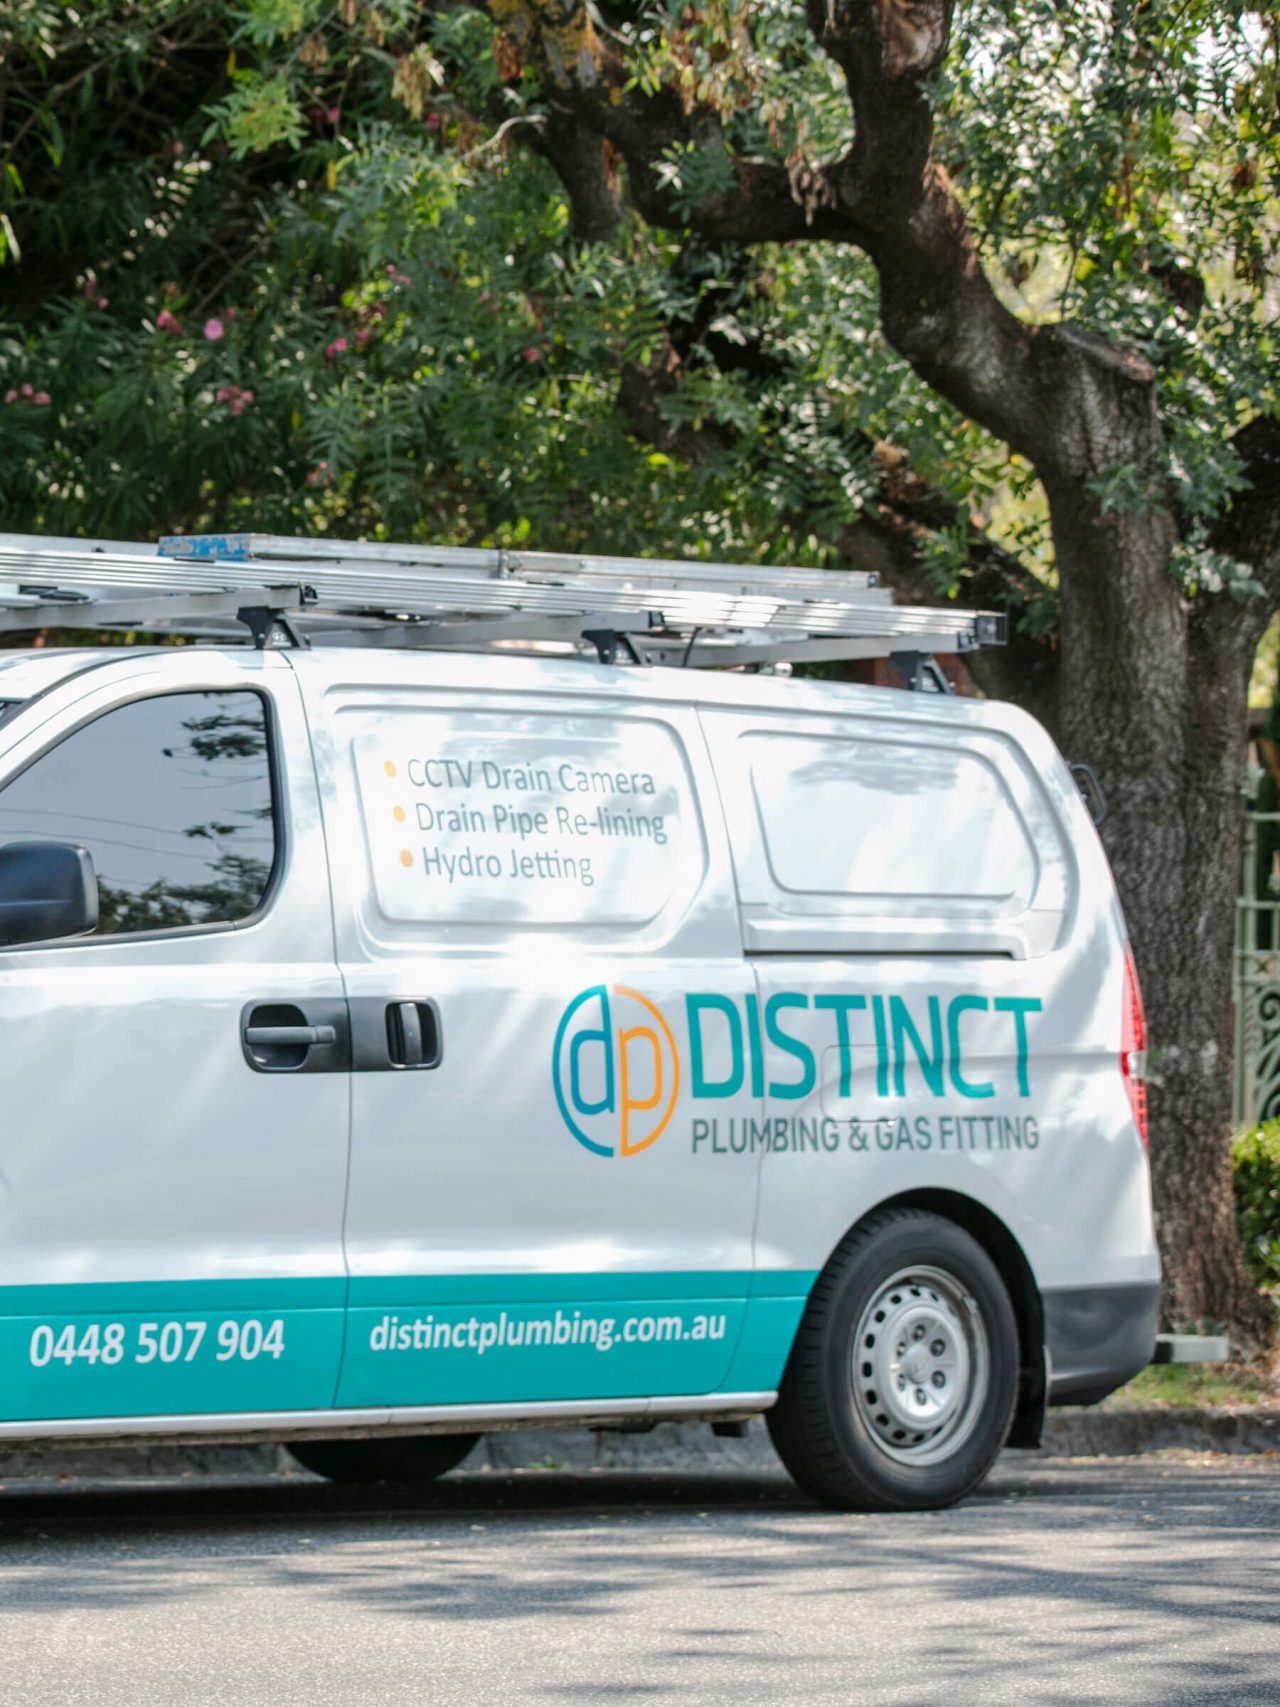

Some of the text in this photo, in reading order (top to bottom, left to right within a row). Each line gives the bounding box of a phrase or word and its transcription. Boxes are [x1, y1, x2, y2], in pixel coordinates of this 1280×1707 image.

[407, 759, 656, 795] CCTV Drain Camera
[416, 803, 668, 845] Drain Pipe Re-lining
[423, 847, 594, 886] Hydro Jetting
[685, 992, 1042, 1100] DISTINCT
[691, 1115, 1040, 1154] PLUMBING & GAS FITTING
[29, 1319, 285, 1367] 0448 507 904
[370, 1310, 726, 1355] distinctplumbing.com.au
